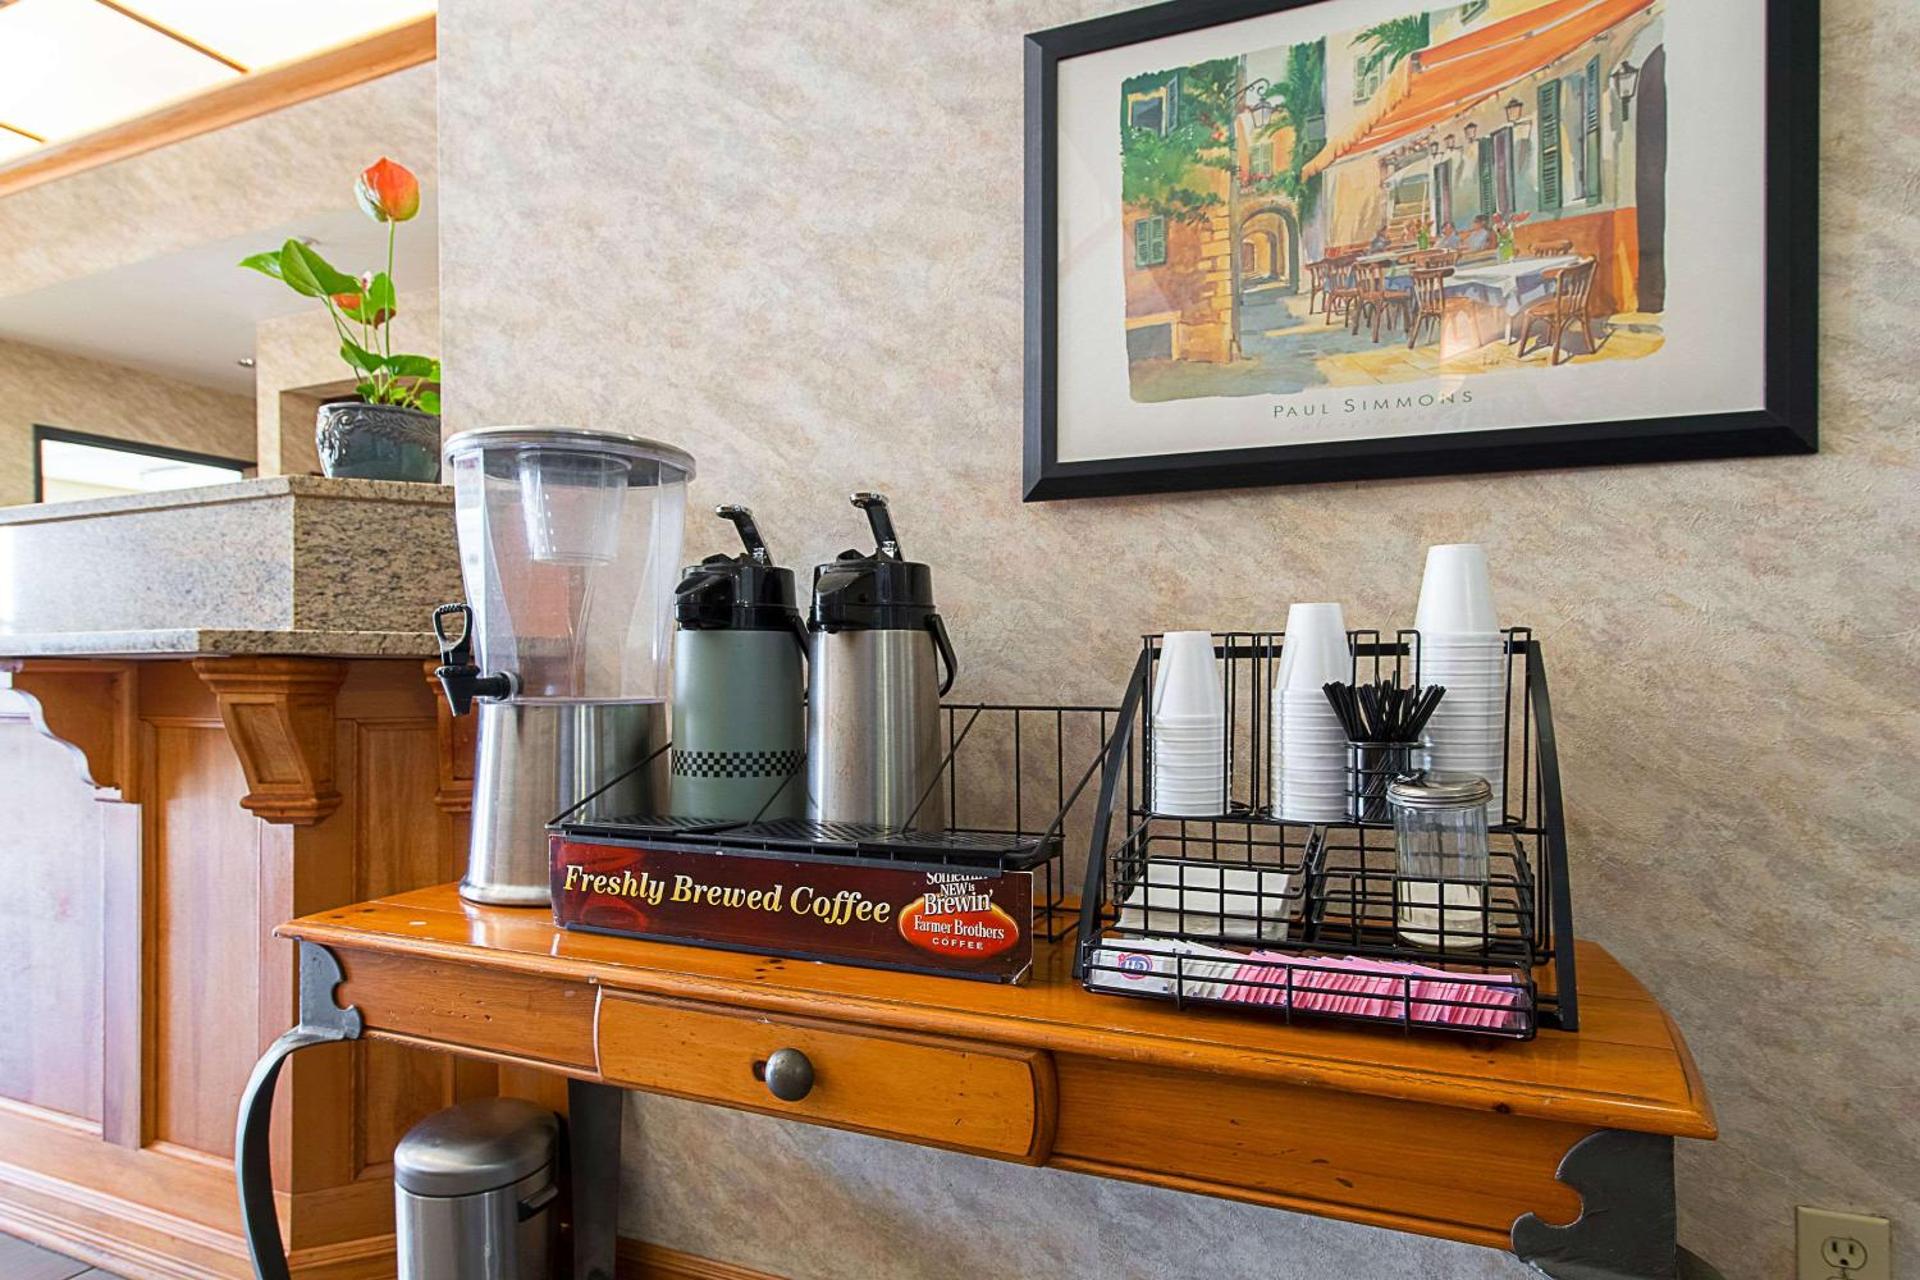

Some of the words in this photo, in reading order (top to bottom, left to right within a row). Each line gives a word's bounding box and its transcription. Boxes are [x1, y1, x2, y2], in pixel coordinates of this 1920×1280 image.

[1273, 404, 1329, 418] PAUL
[563, 864, 665, 906] Freshly
[670, 874, 783, 913] Brewed
[790, 886, 891, 926] Coffee
[940, 882, 969, 896] NEW
[968, 882, 975, 892] is
[923, 889, 994, 915] Brewin'
[914, 914, 951, 934] Farmer
[954, 919, 1005, 940] Brothers
[932, 937, 984, 950] COFFEE
